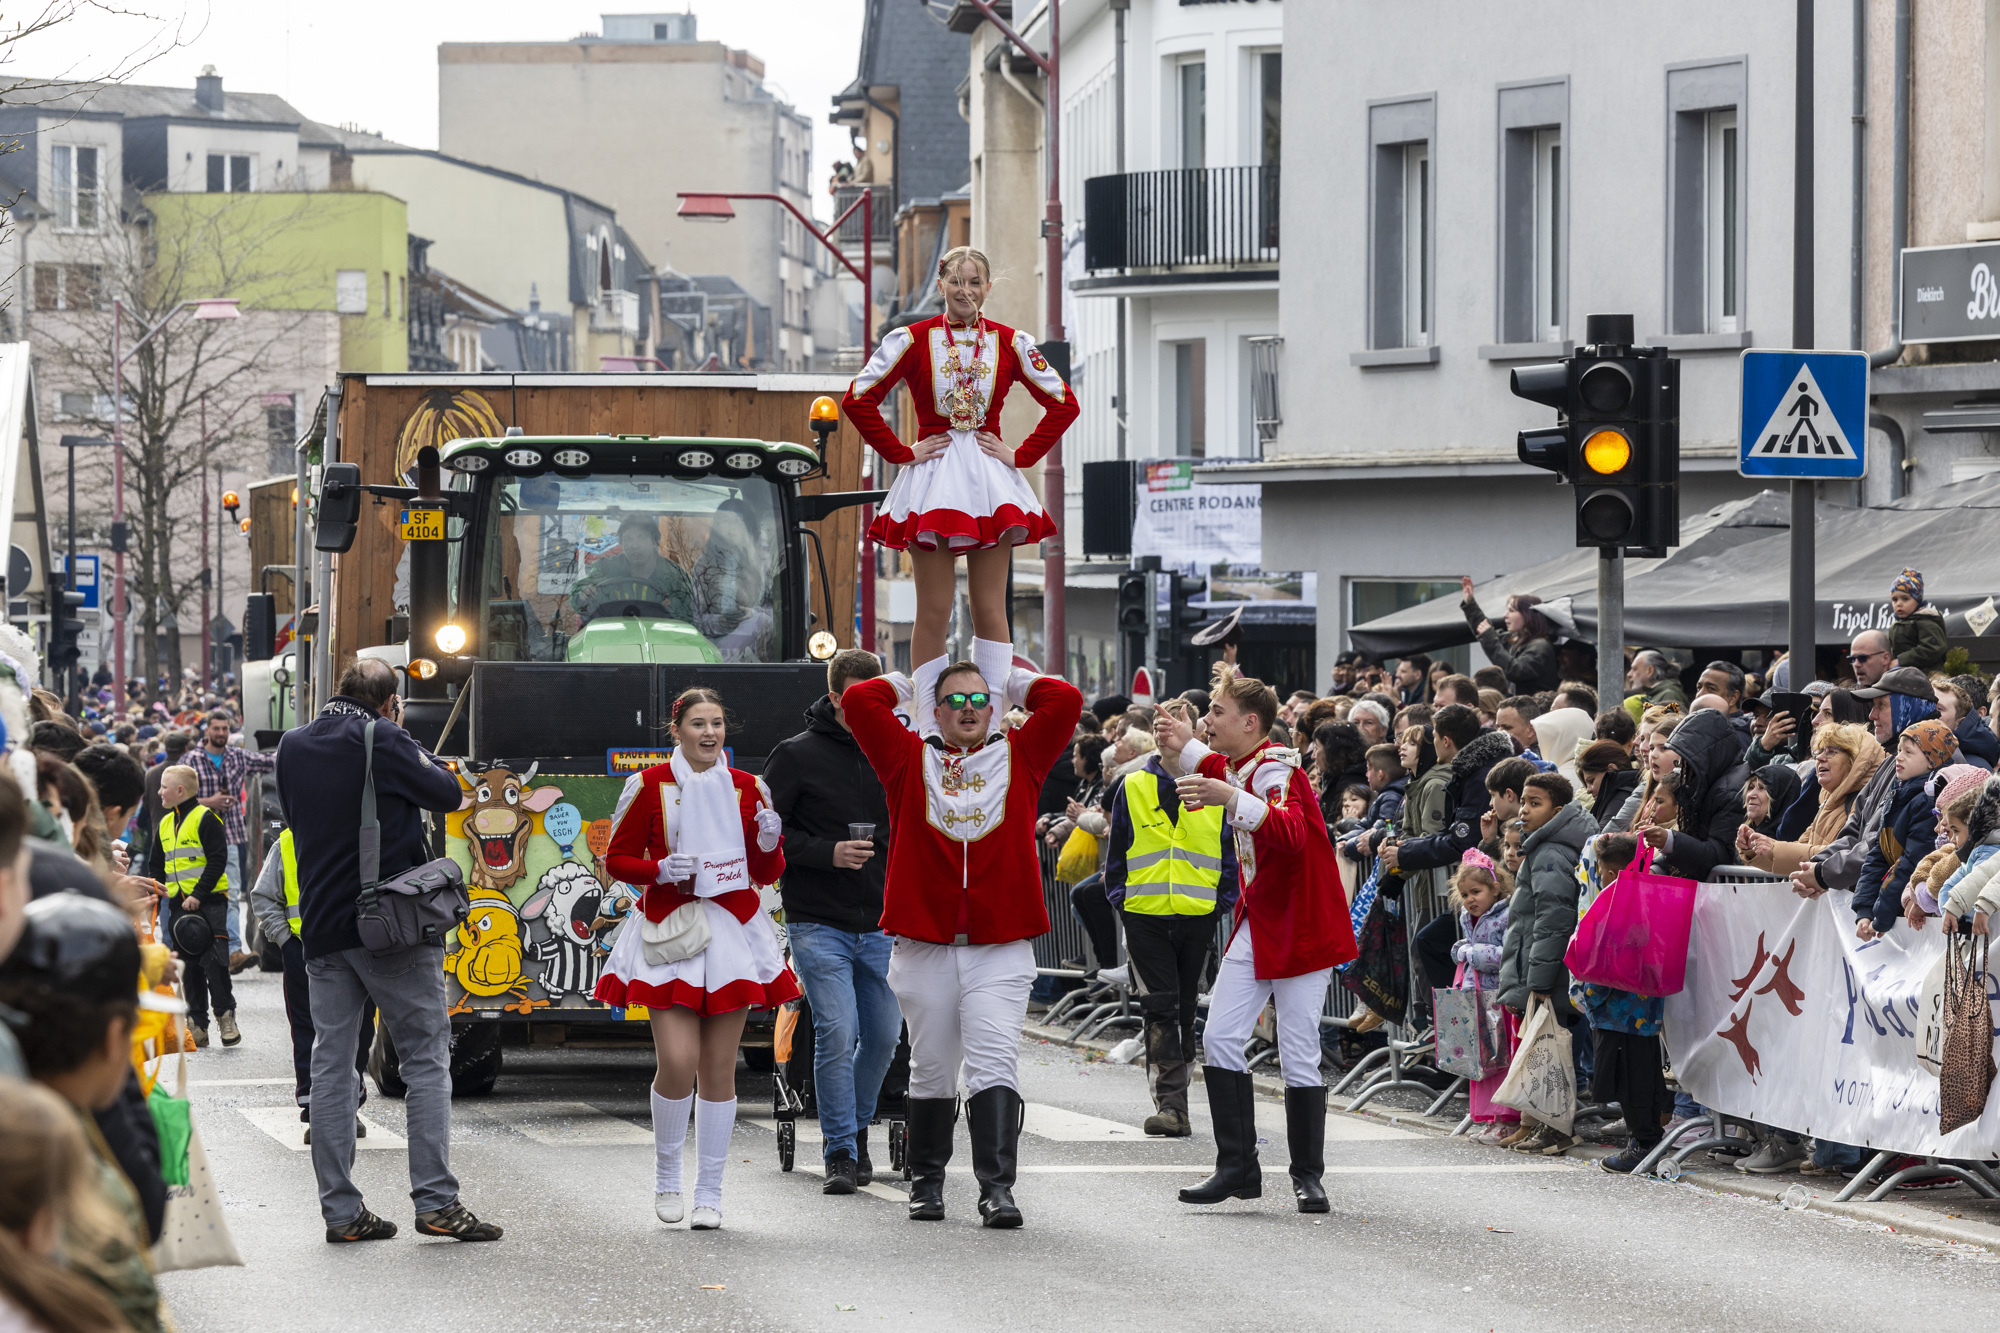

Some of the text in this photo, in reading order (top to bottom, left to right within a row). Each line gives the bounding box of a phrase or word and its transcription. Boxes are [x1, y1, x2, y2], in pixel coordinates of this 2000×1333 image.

[1916, 286, 1944, 302] Diekirch
[1966, 262, 2000, 320] Br
[1150, 497, 1195, 513] CENTRE
[414, 512, 431, 524] SF
[407, 525, 440, 538] 4104
[1832, 603, 1875, 637] Tripel
[619, 750, 650, 759] BAUER
[611, 762, 633, 773] VIEL
[549, 811, 570, 821] BAUER
[552, 827, 573, 838] ESCH
[716, 868, 742, 885] Polch
